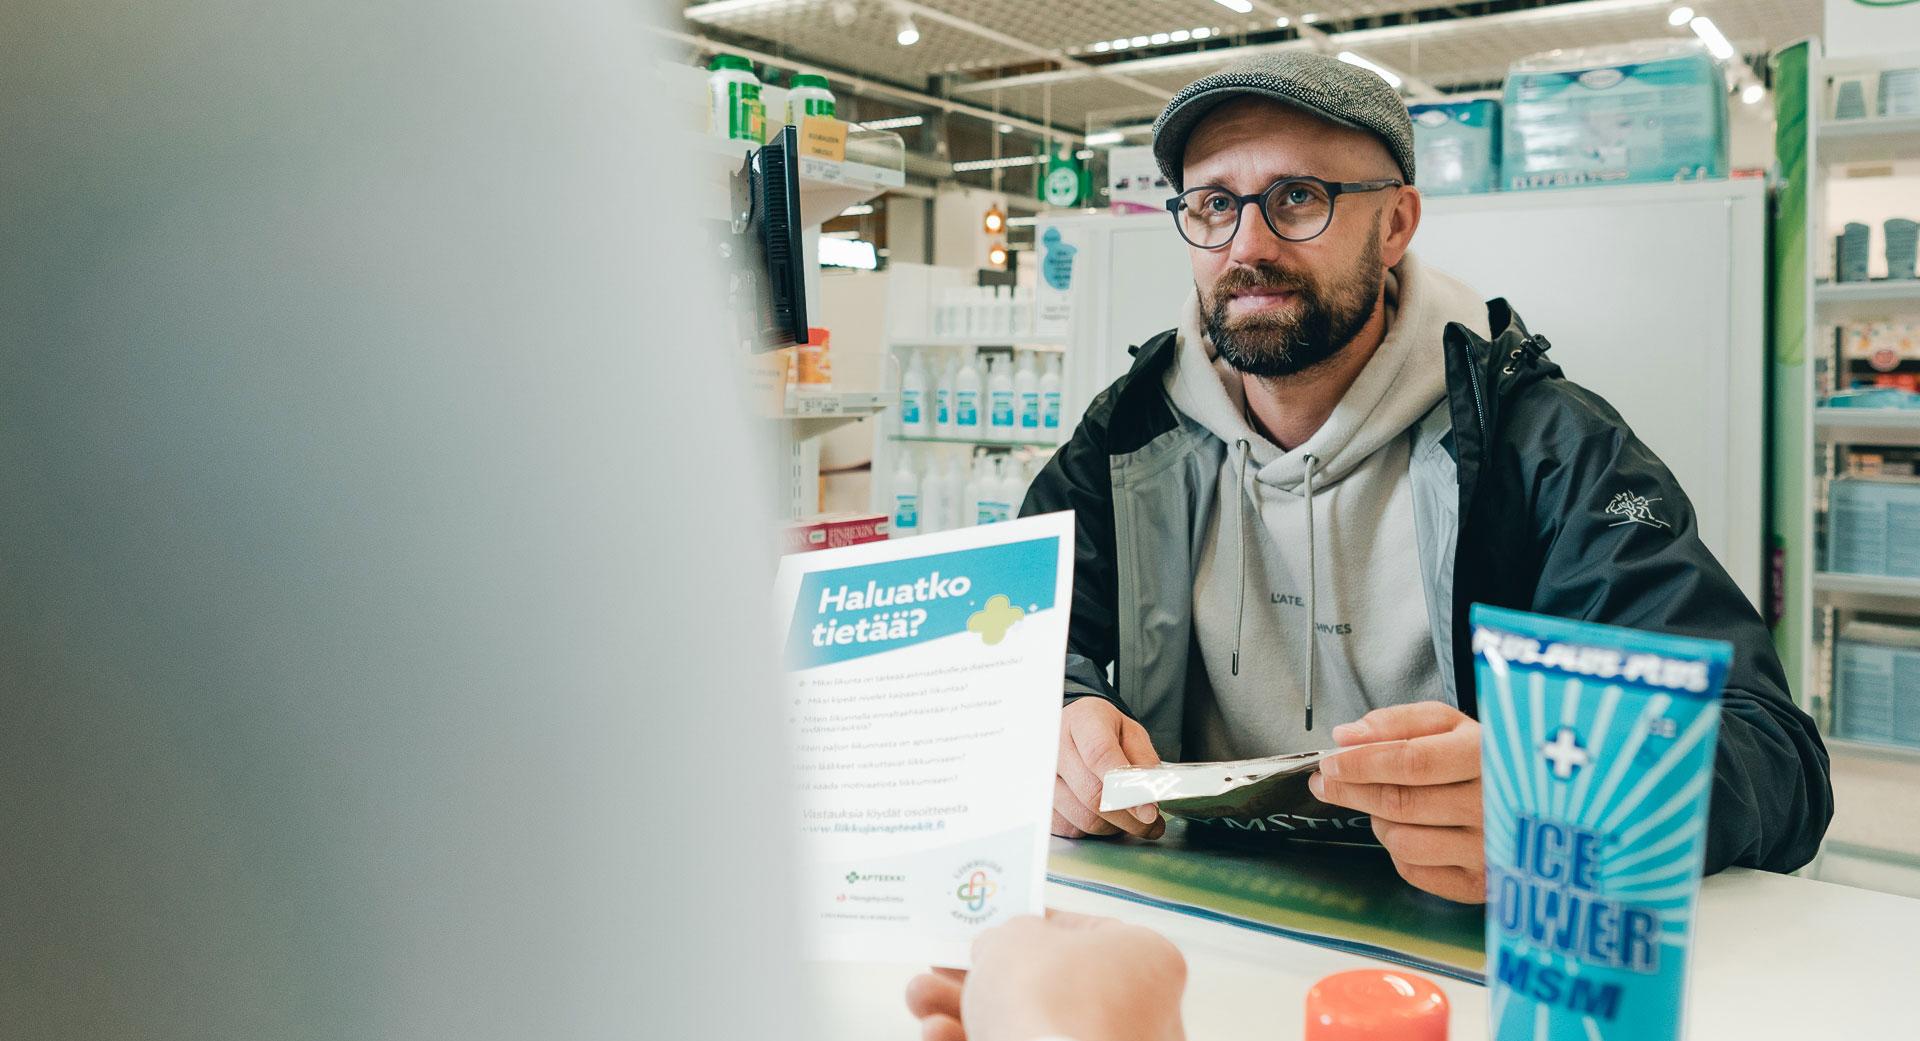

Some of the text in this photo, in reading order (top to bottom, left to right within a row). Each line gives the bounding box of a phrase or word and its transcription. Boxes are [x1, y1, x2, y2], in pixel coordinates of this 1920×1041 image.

[817, 570, 972, 615] Haluatko
[1271, 591, 1306, 608] L'ATE
[811, 608, 929, 648] tietää?
[1315, 622, 1353, 635] HIVES
[1516, 815, 1602, 890] ICE
[1493, 868, 1661, 973] OWER
[1496, 943, 1626, 1023] MSM
